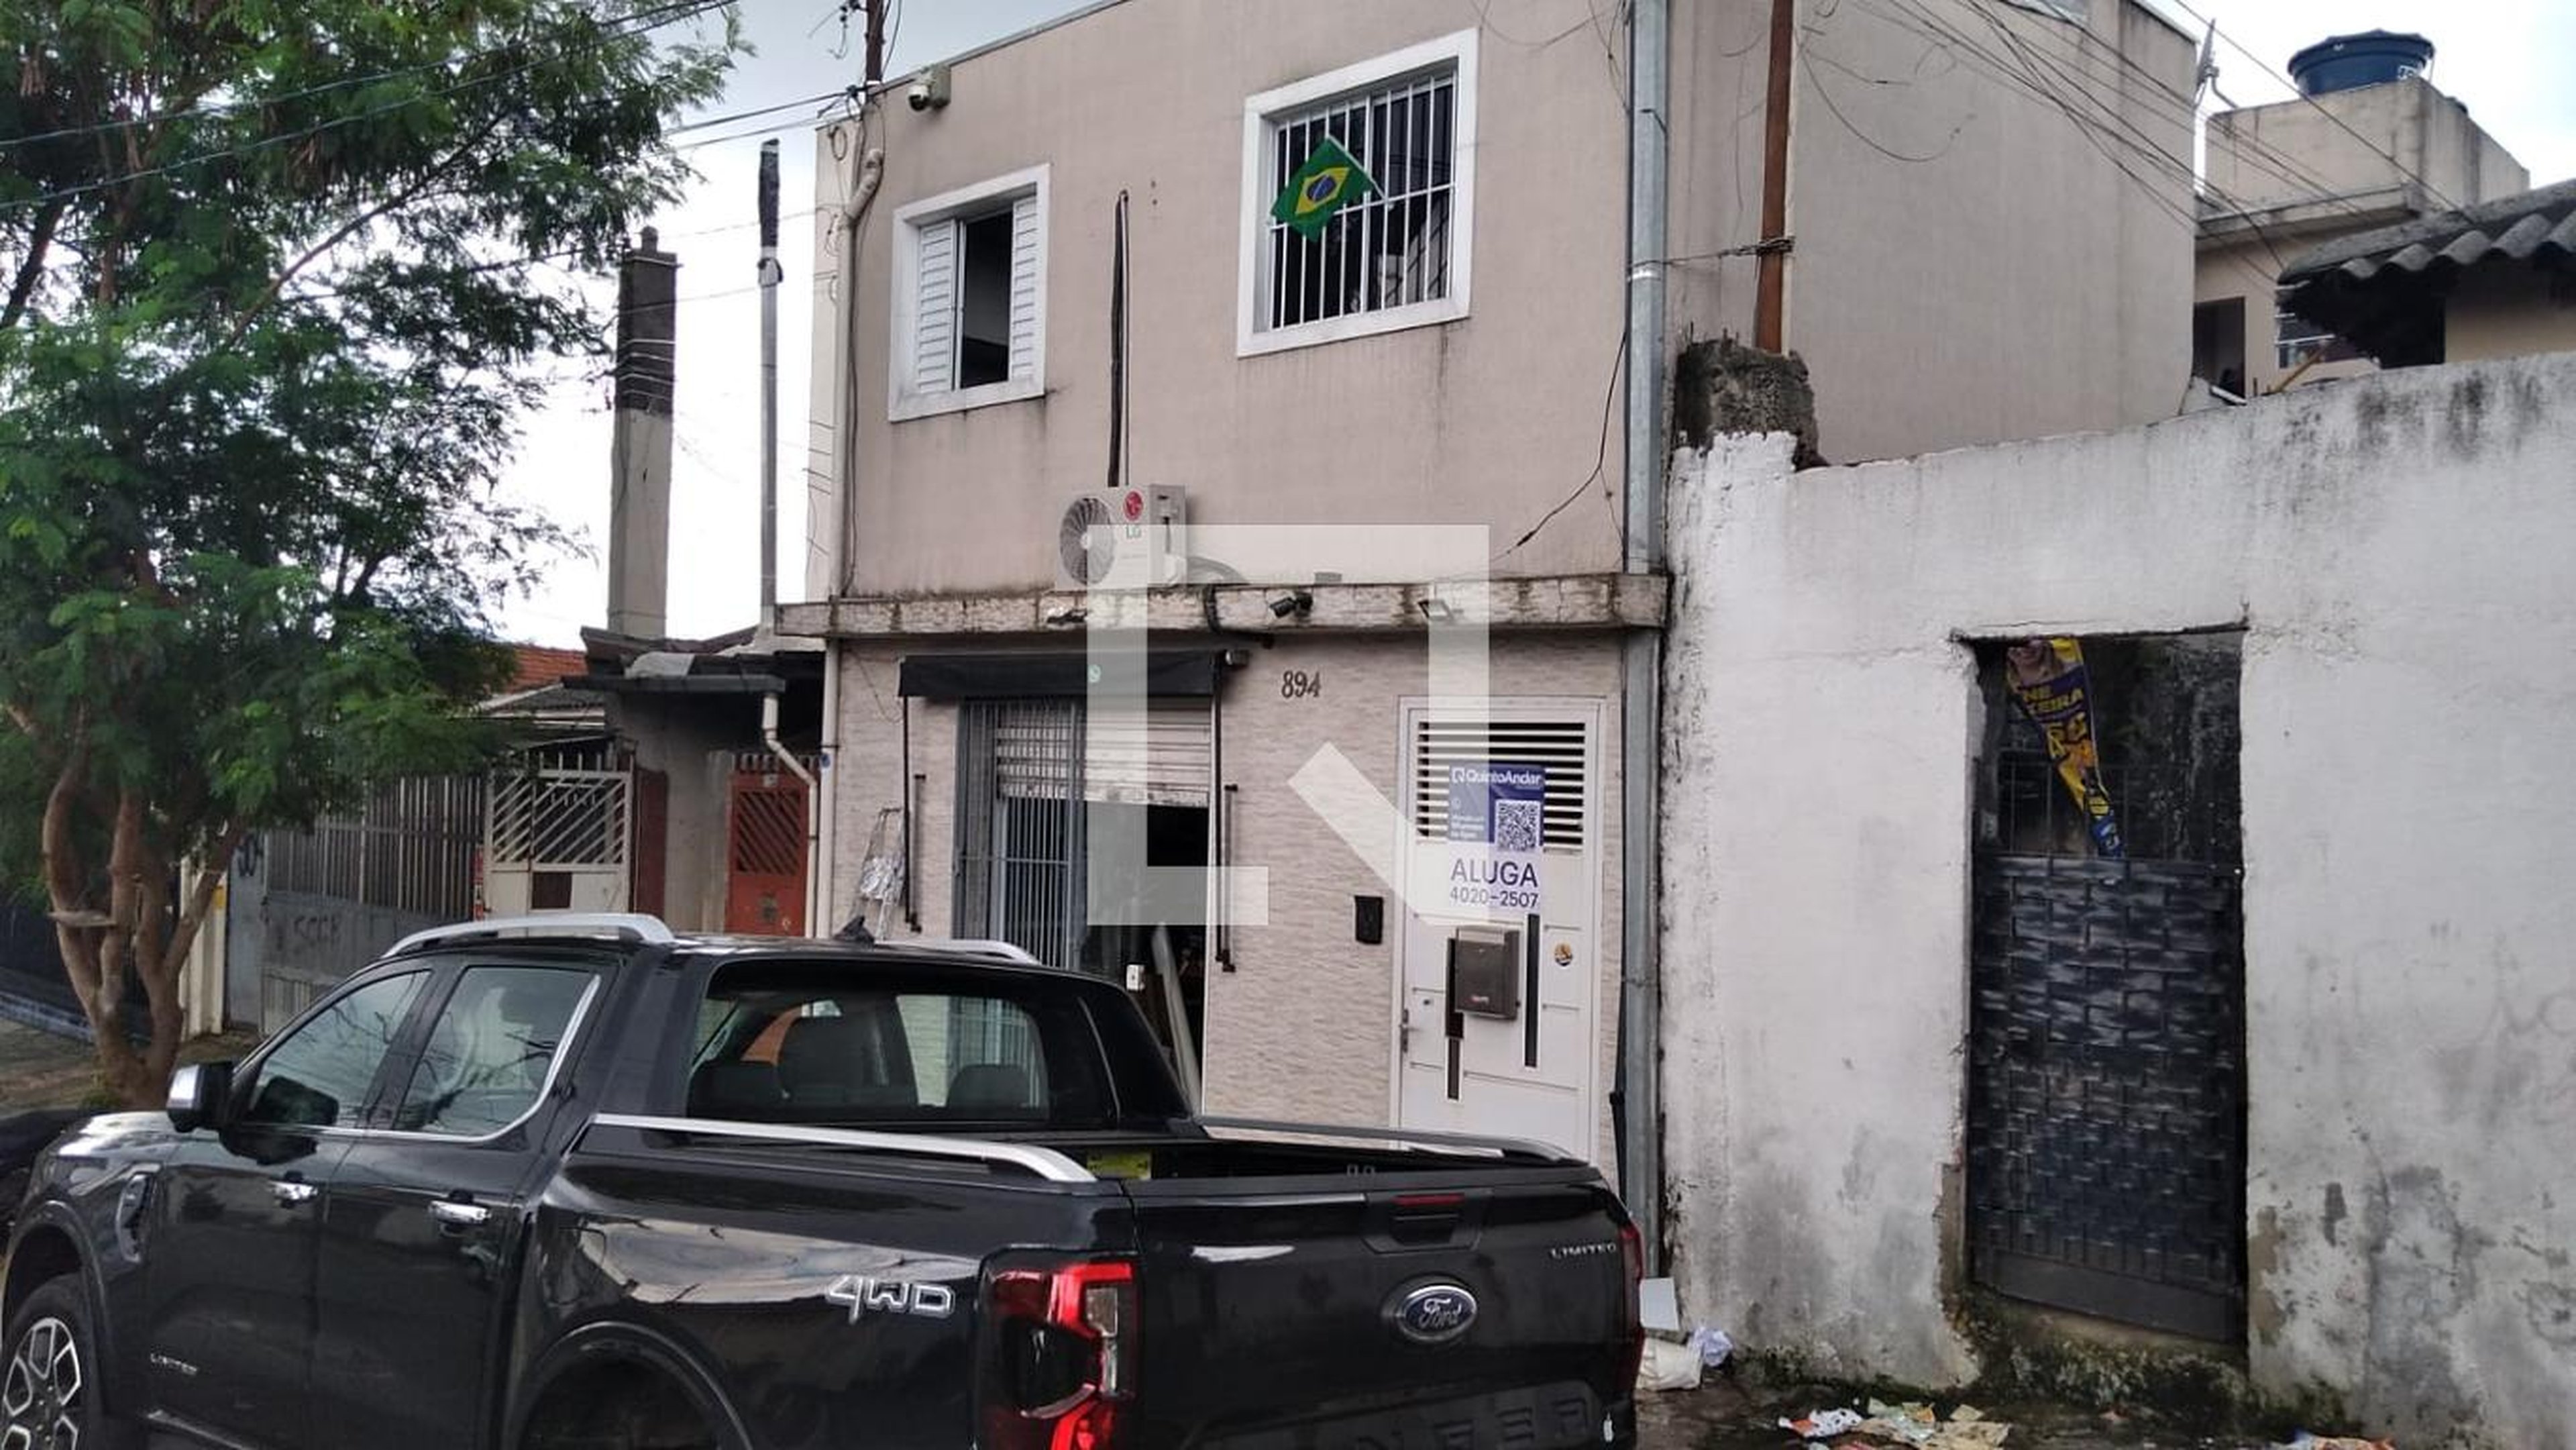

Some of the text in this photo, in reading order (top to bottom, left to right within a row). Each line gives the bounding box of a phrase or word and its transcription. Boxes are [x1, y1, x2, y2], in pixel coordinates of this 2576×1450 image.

[1282, 670, 1322, 698] 894
[1466, 769, 1542, 786] QuintoAndar
[1450, 858, 1538, 888] ALUGA
[1450, 886, 1539, 907] 4020-2507
[1551, 1241, 1616, 1259] LIMITED
[825, 1274, 955, 1325] 4WD
[1418, 1297, 1462, 1329] Ford
